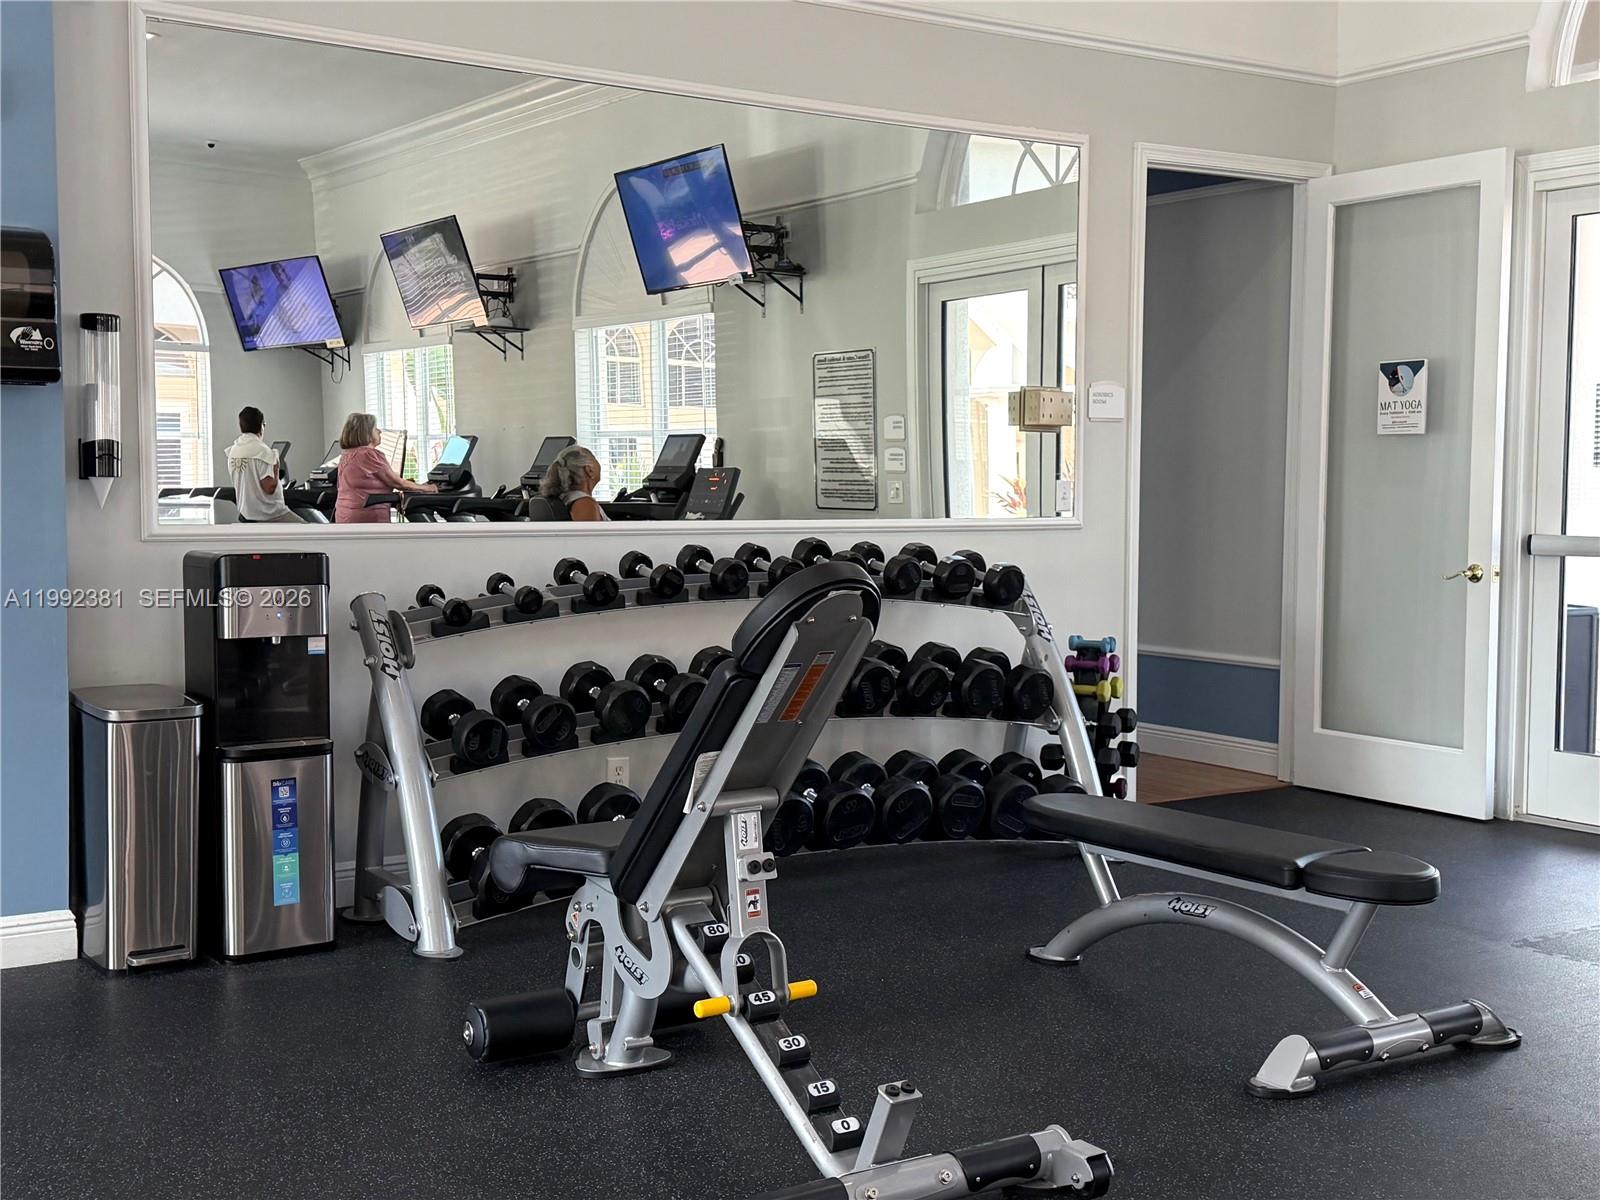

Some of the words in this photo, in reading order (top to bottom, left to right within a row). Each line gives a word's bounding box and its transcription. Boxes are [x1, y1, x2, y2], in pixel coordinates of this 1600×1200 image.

[1380, 401, 1398, 411] MAT
[1400, 400, 1422, 410] YOGA
[369, 609, 401, 680] HOIST
[1168, 896, 1218, 919] HOIST
[707, 925, 725, 935] 80
[614, 945, 650, 985] HOIST
[753, 992, 771, 1003] 45
[783, 1037, 800, 1049] 30
[813, 1082, 830, 1094] 15
[841, 1120, 850, 1130] 0
